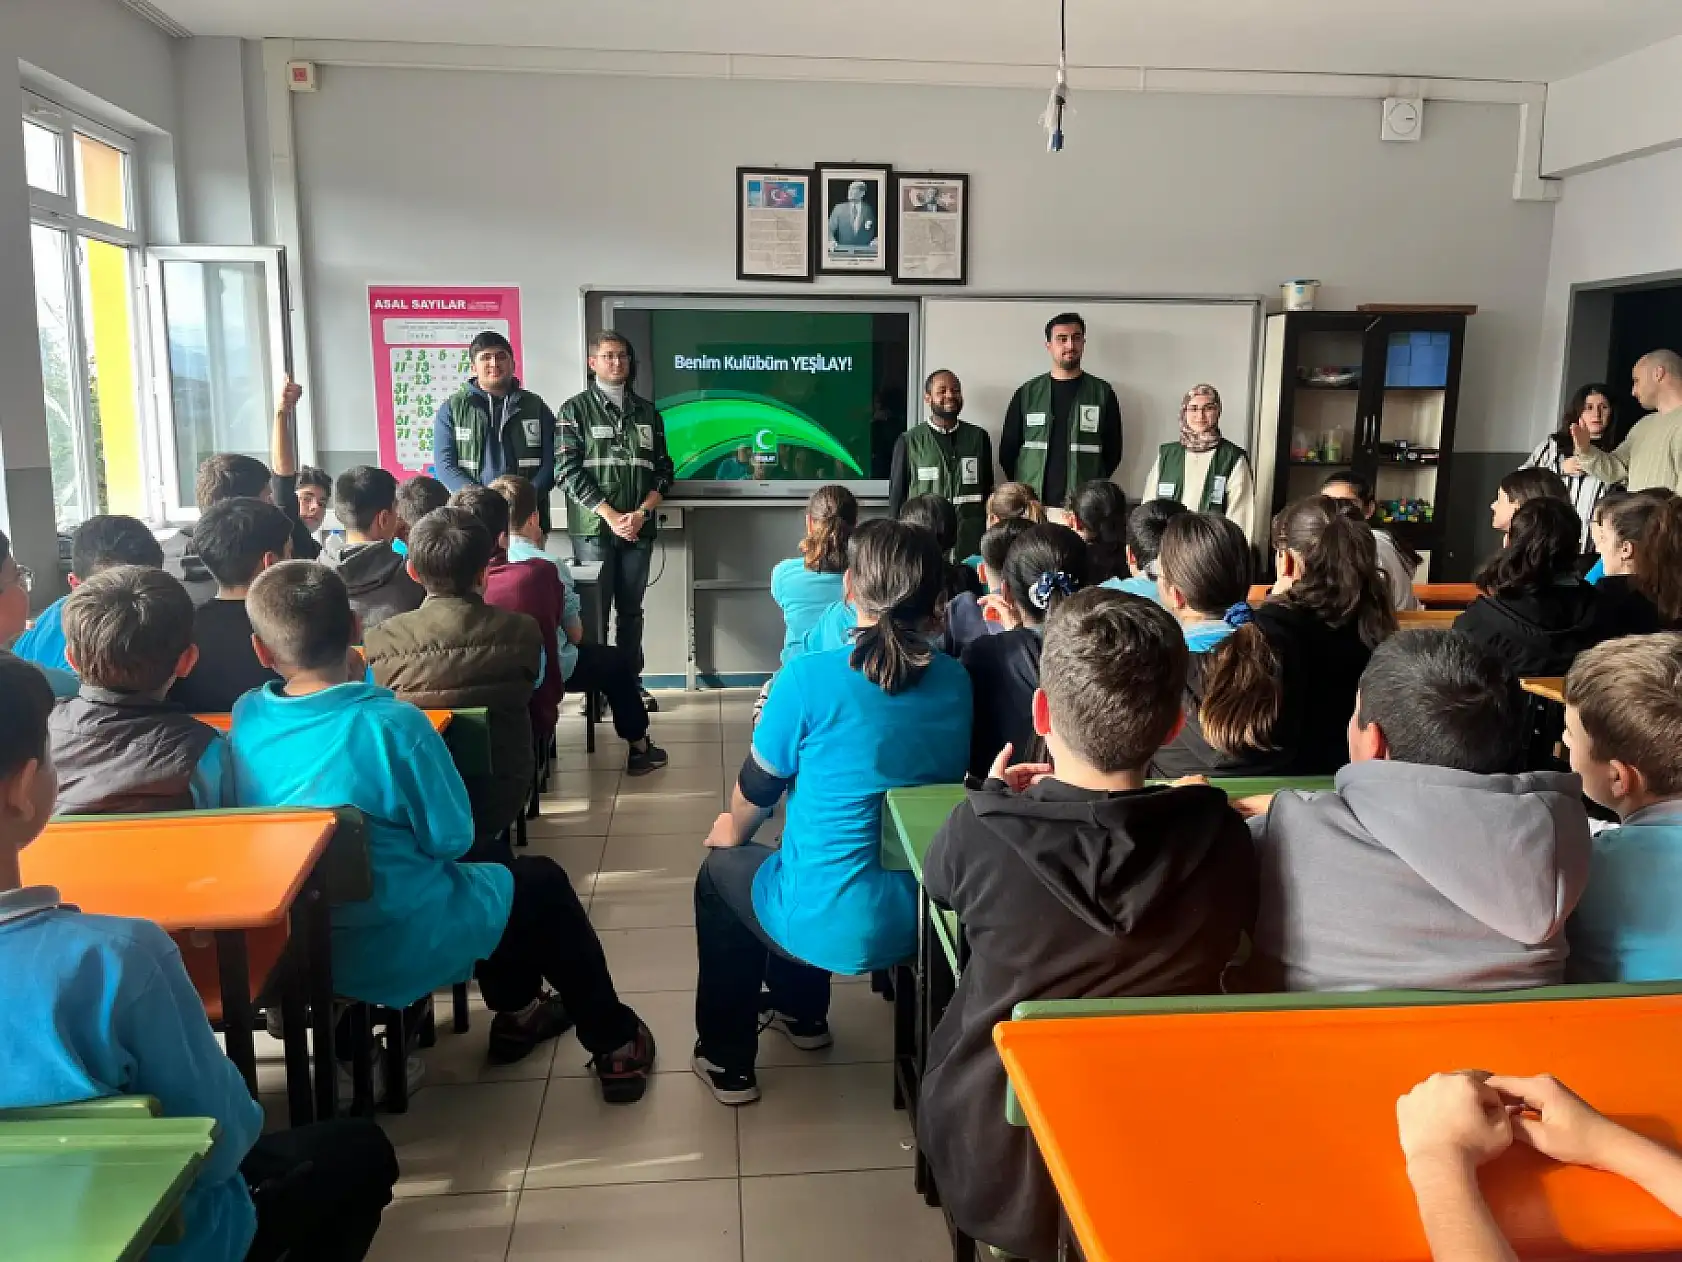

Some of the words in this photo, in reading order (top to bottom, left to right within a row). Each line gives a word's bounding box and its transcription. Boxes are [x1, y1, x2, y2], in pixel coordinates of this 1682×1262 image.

[374, 299, 409, 310] ASAL
[412, 299, 467, 310] SAYILAR
[405, 349, 413, 361] 2
[417, 349, 426, 361] 3
[415, 361, 429, 373] 13
[674, 354, 721, 370] Benim
[724, 354, 788, 371] Kulübüm
[790, 352, 853, 374] YEŞİLAY!
